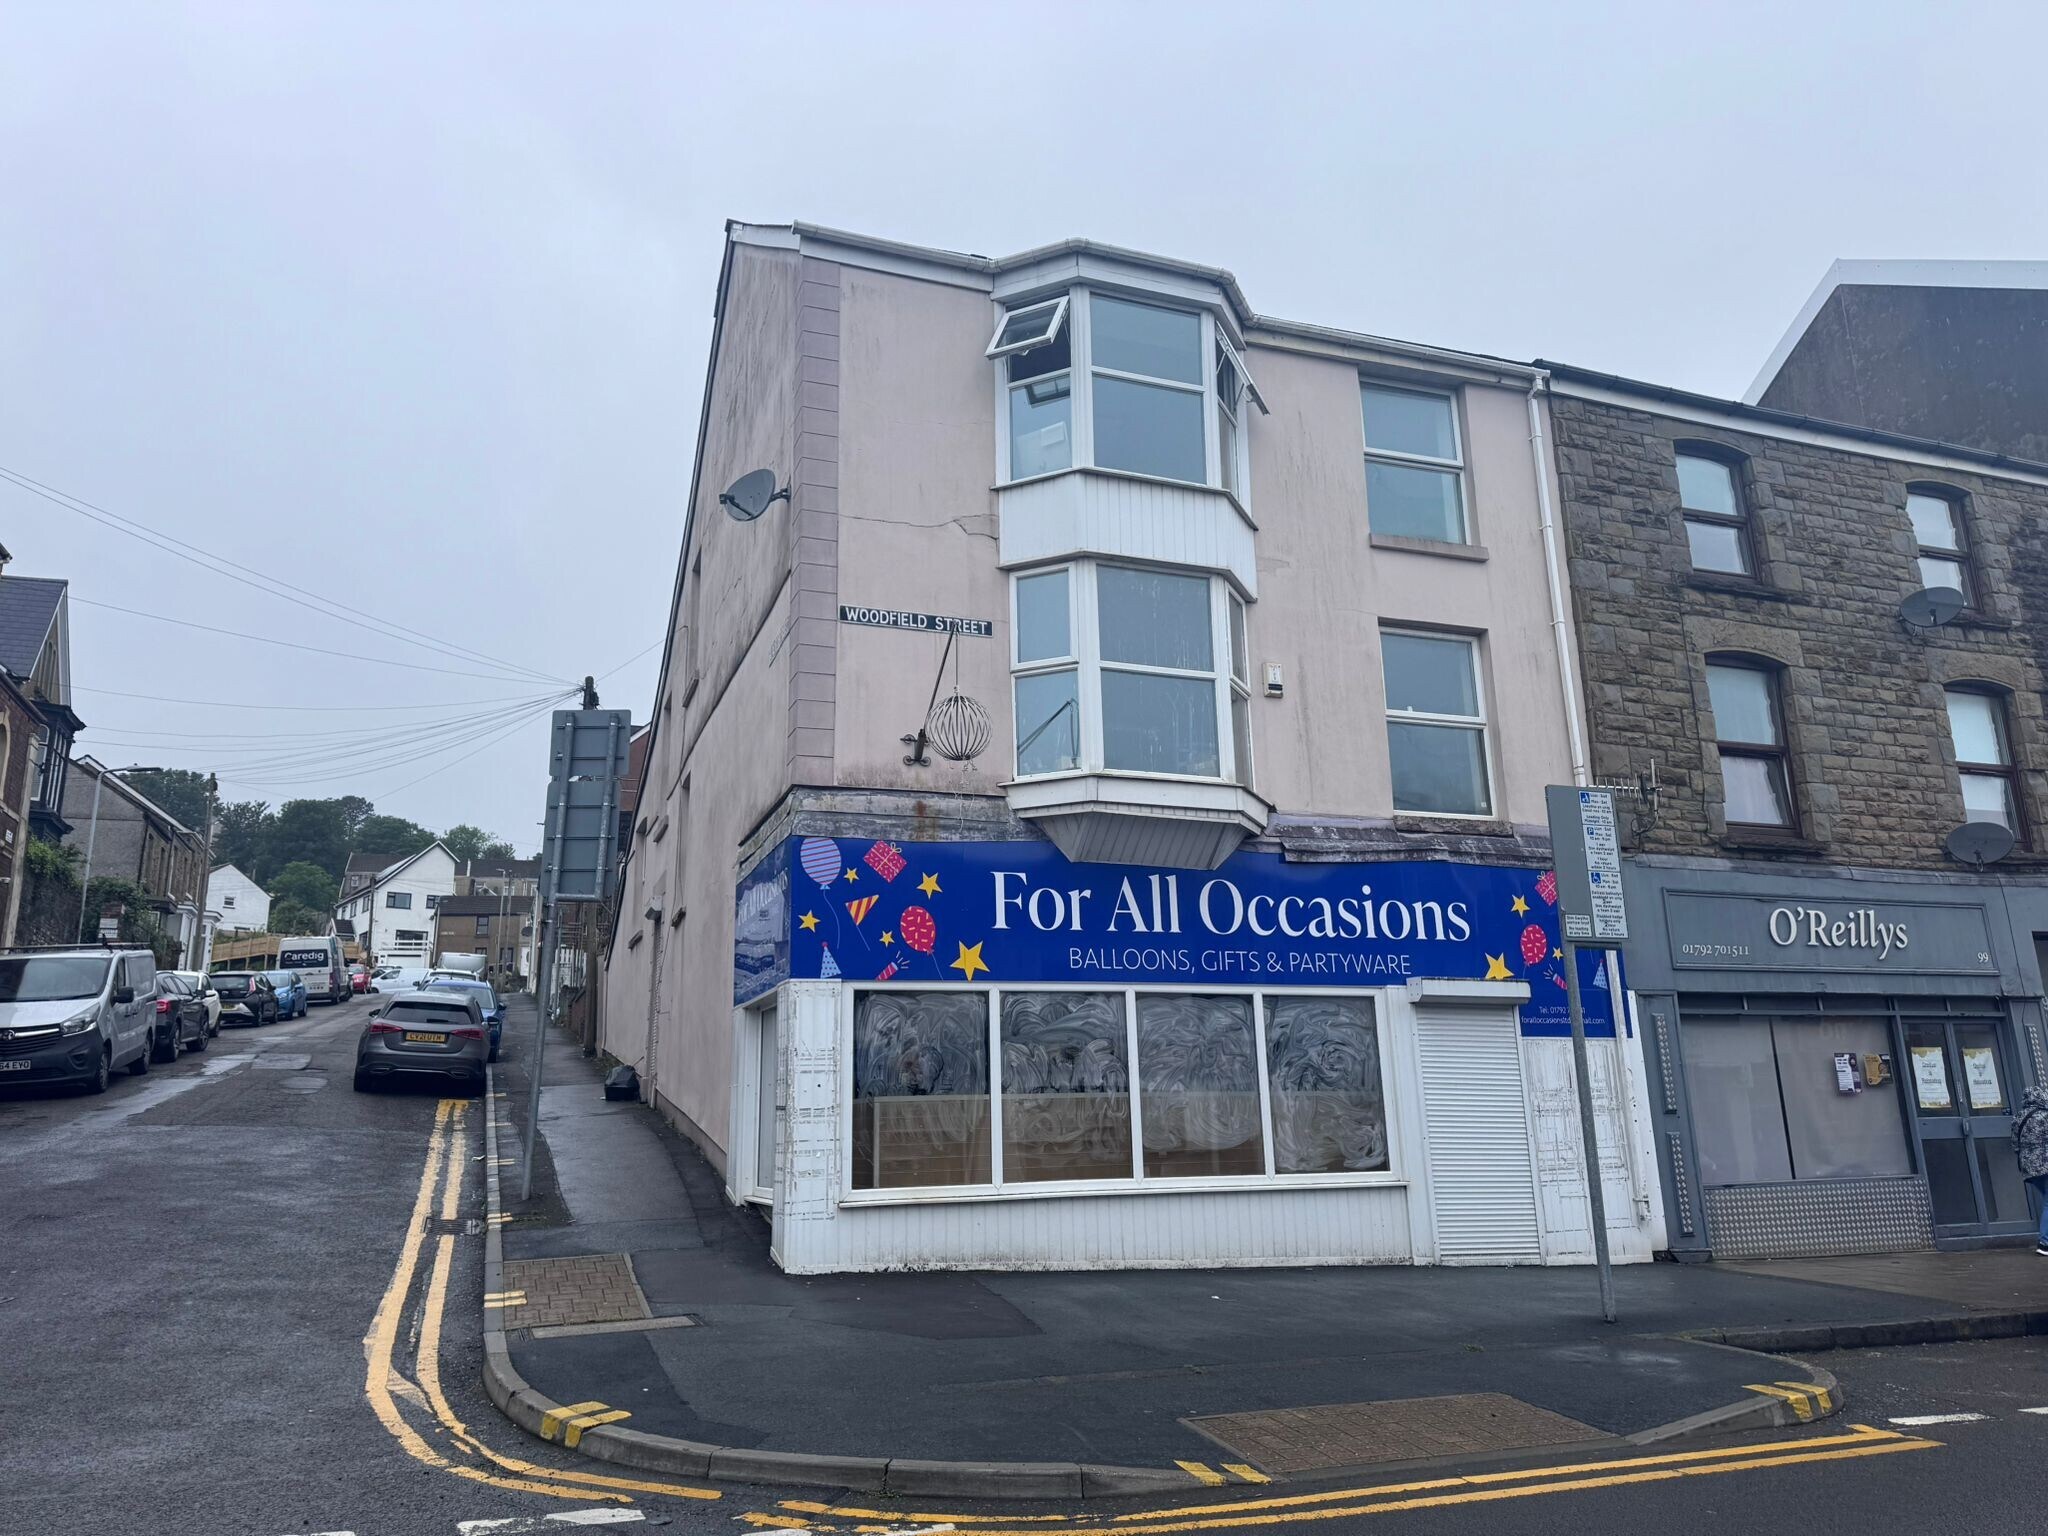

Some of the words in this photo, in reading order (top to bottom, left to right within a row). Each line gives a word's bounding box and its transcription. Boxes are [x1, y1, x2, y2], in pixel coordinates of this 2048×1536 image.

[844, 607, 928, 628] WOODFIELD
[935, 616, 988, 634] STREET
[990, 871, 1092, 931] For
[1106, 874, 1182, 933] All
[1199, 879, 1470, 942] Occasions
[1769, 906, 1908, 961] O'Reillys
[284, 952, 324, 961] Caredig
[1069, 948, 1195, 974] BALLOONS,
[1201, 950, 1260, 972] GIFTS
[1266, 951, 1284, 972] &
[1290, 952, 1412, 975] PARTYWARE
[1682, 944, 1712, 956] 01792
[1714, 945, 1749, 958] 701511
[1977, 951, 1988, 963] 99
